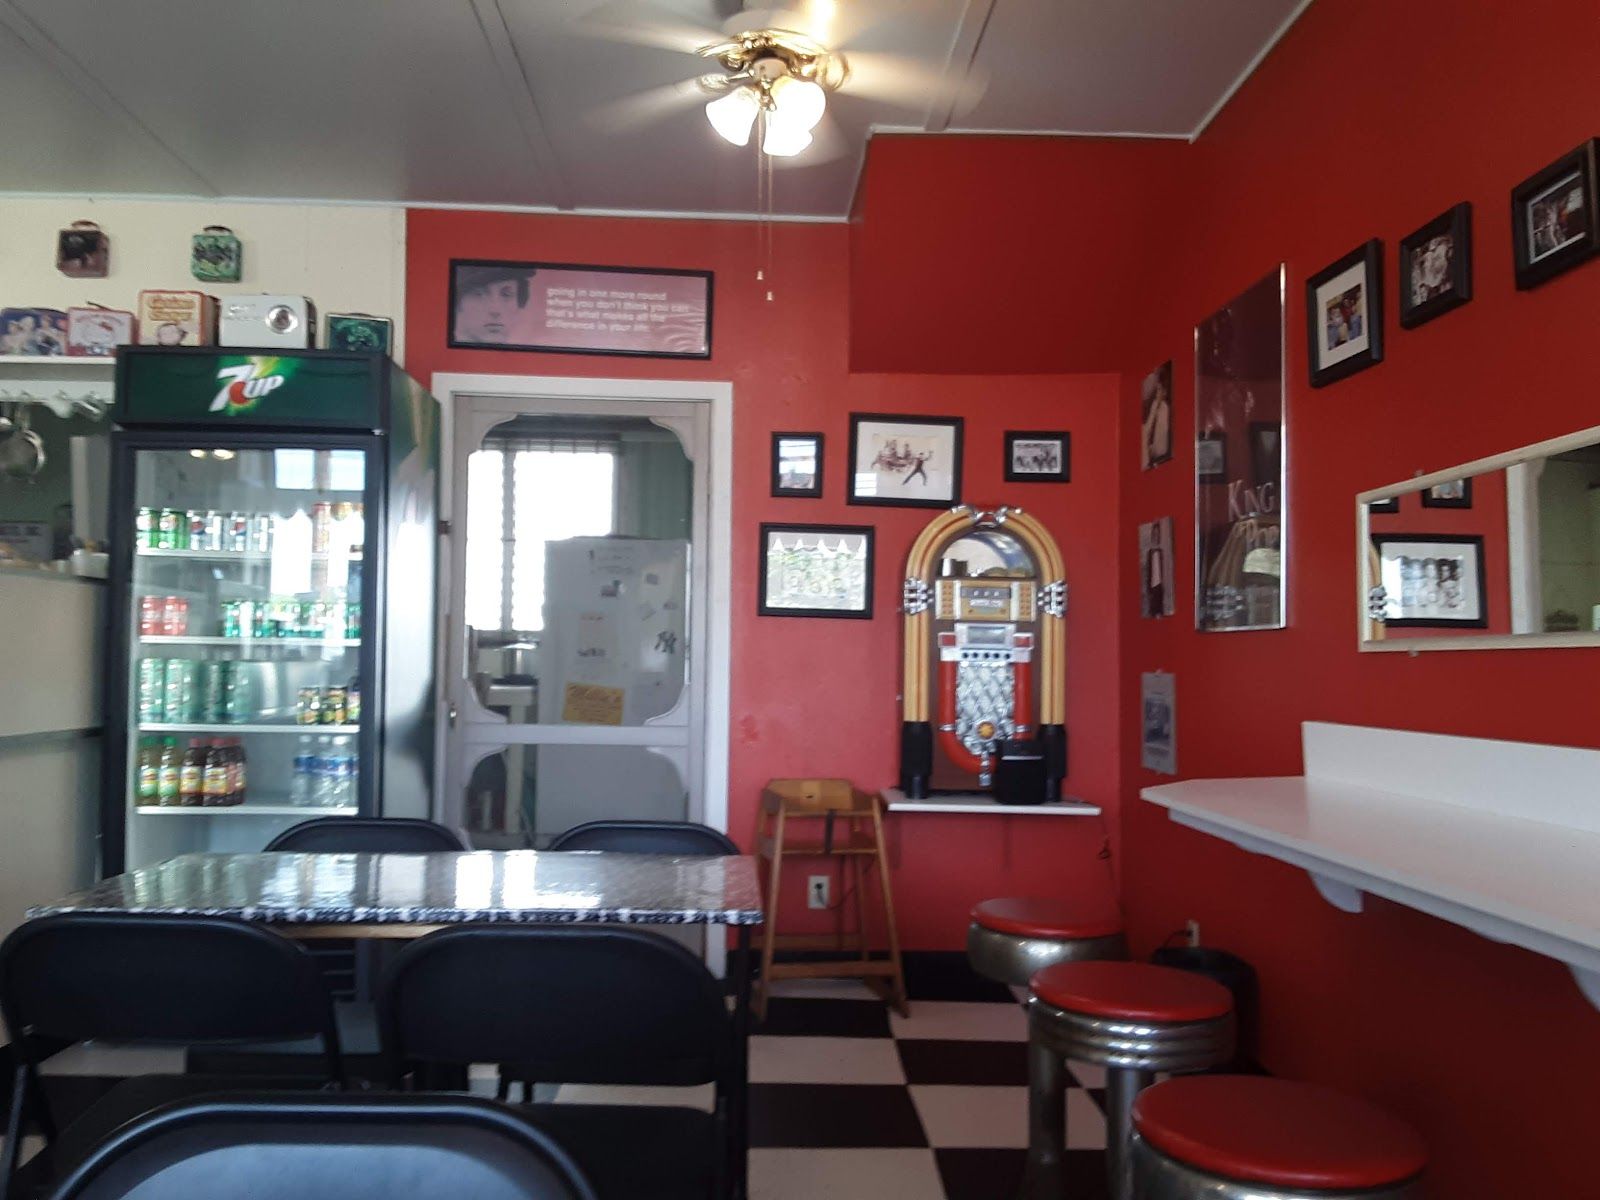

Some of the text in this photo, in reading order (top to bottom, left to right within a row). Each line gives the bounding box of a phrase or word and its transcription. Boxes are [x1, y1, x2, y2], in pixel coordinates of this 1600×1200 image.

[546, 287, 667, 301] going in one more round
[546, 298, 573, 307] when
[576, 301, 594, 310] you
[650, 304, 669, 313] you
